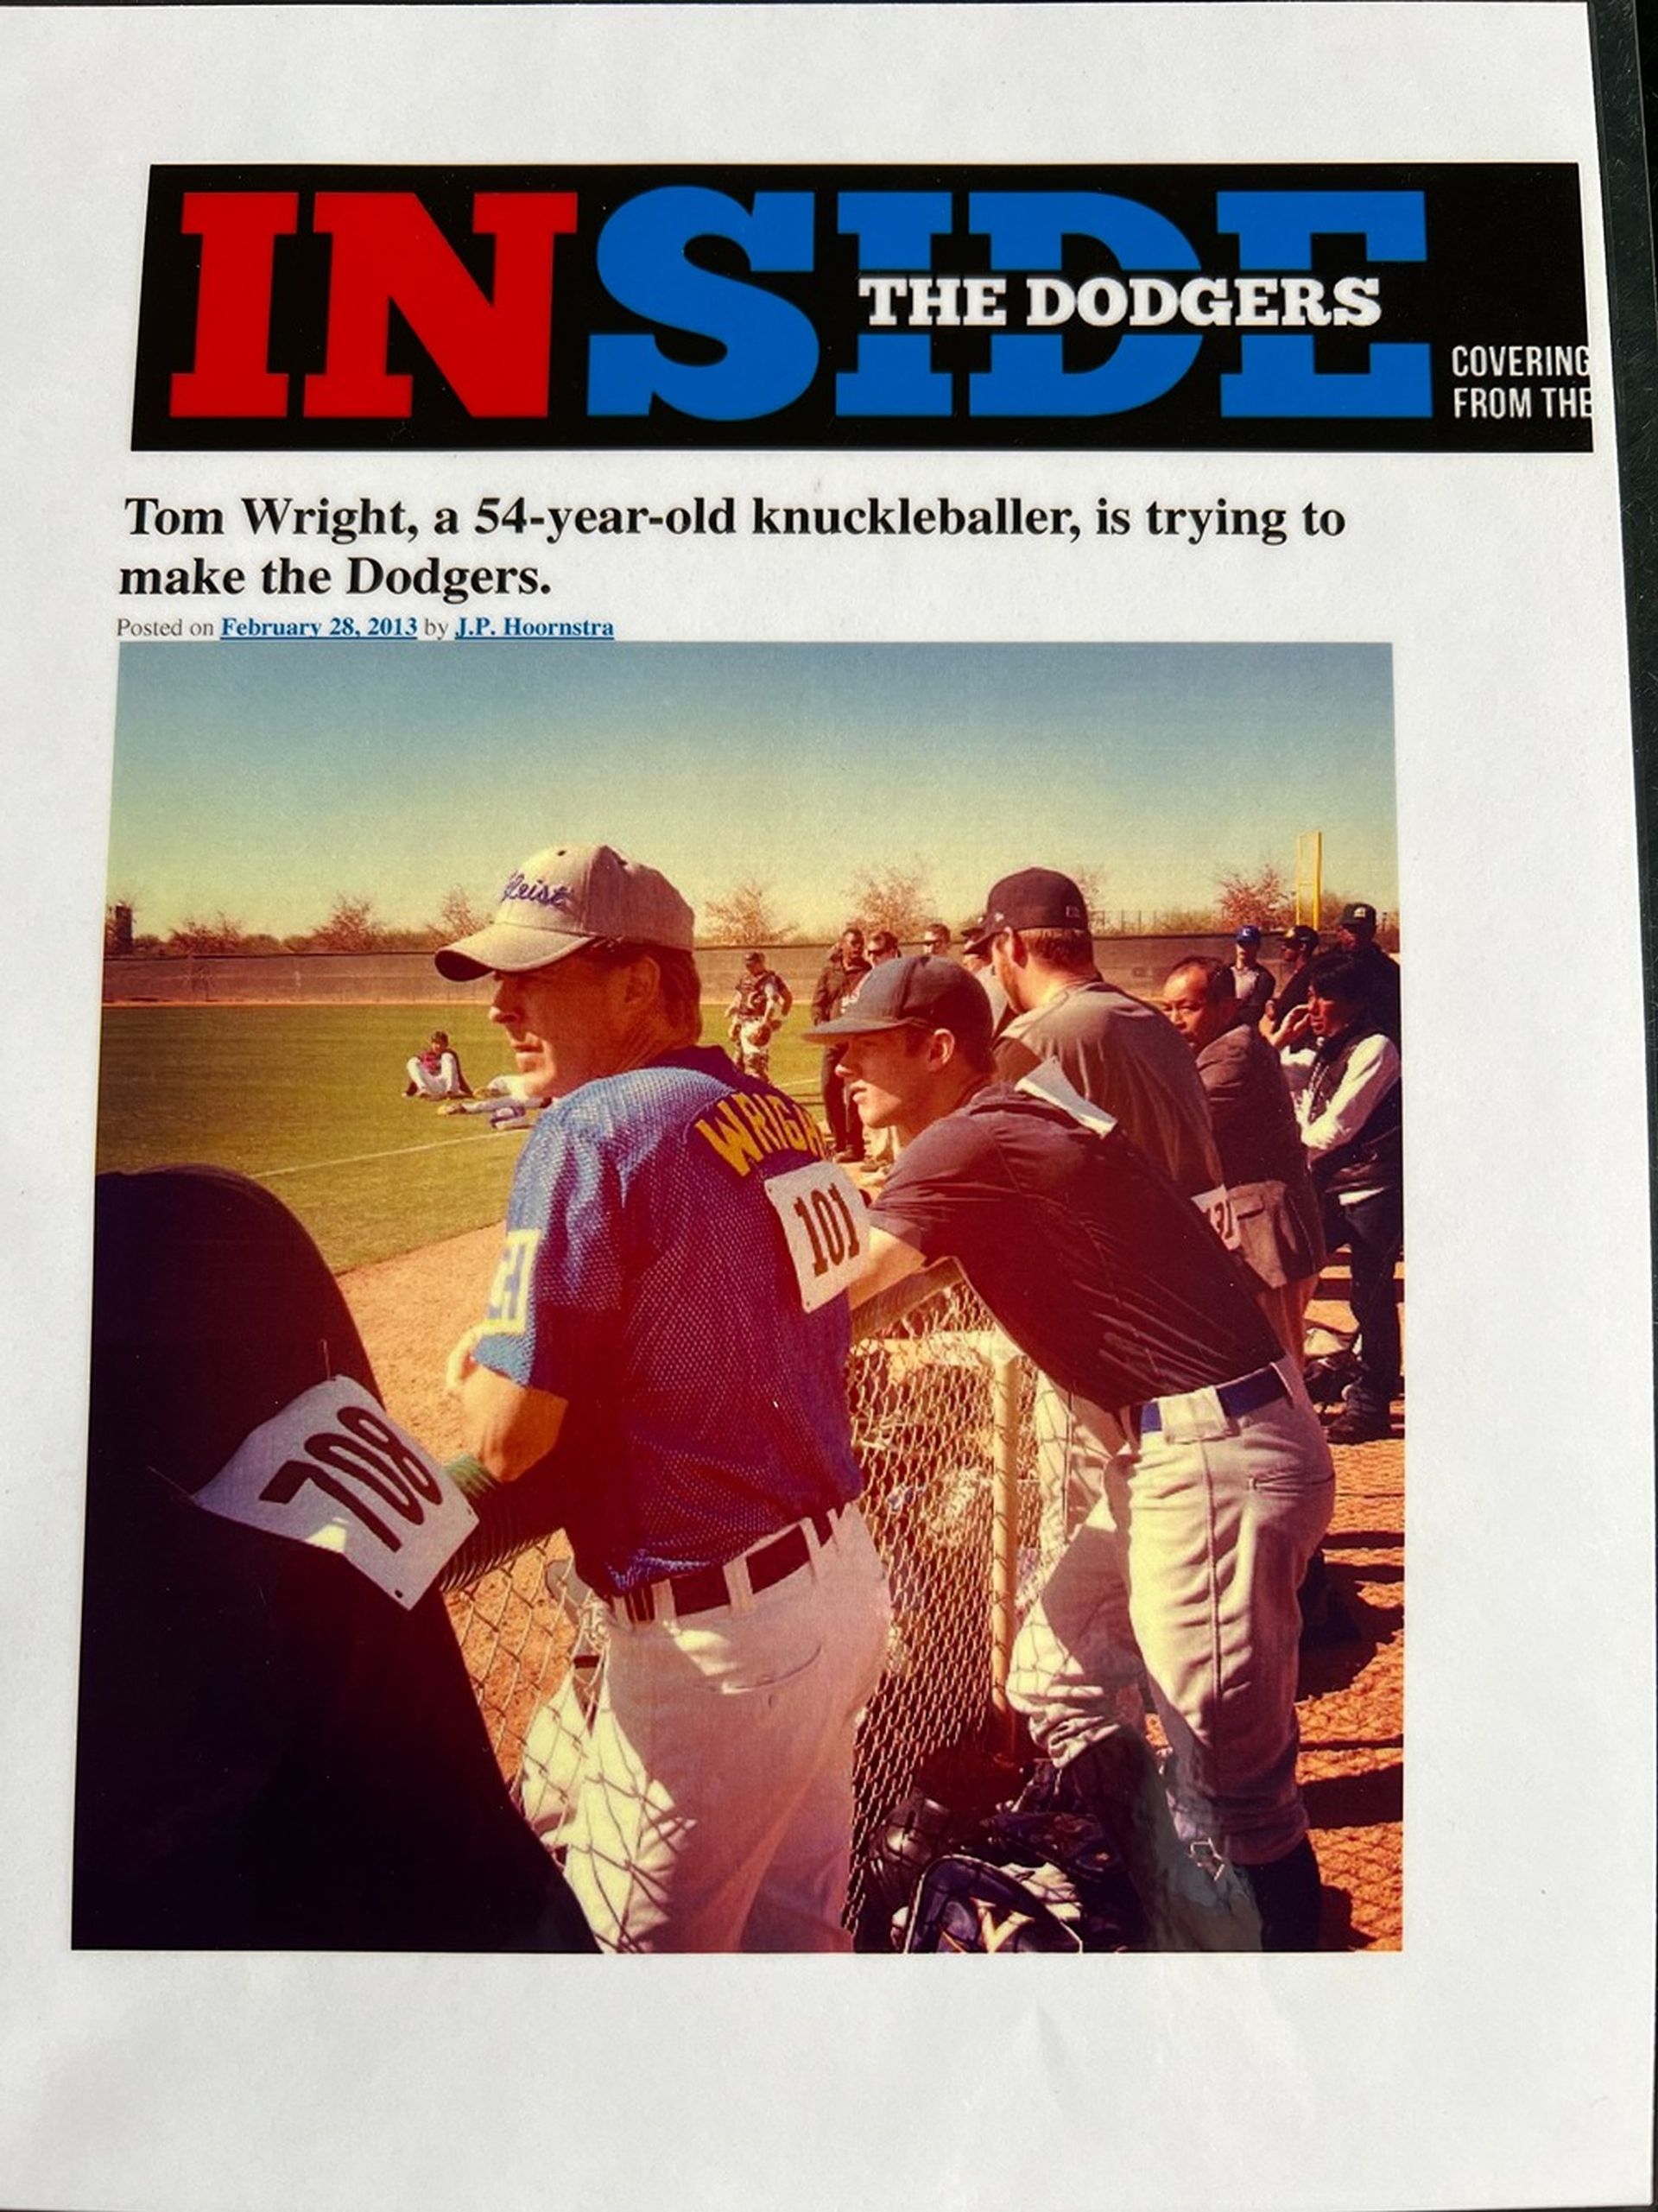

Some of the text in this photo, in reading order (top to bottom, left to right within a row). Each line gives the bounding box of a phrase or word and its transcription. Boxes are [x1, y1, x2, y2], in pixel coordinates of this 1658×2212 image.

[169, 184, 1433, 421] INSIDE
[858, 276, 1382, 327] THE DODGERS
[1452, 345, 1590, 377] COVERING
[1453, 387, 1592, 419] FROM THE
[124, 497, 1346, 547] Tom Wright, a 54-year-old knuckleballer, is trying to
[118, 556, 552, 605] make the Dodgers.
[117, 617, 614, 641] Posted on February 28, 2013 by J.P. Hoornstra
[693, 1091, 826, 1177] WRIGH
[794, 1182, 861, 1277] 101
[259, 1406, 443, 1553] 708
